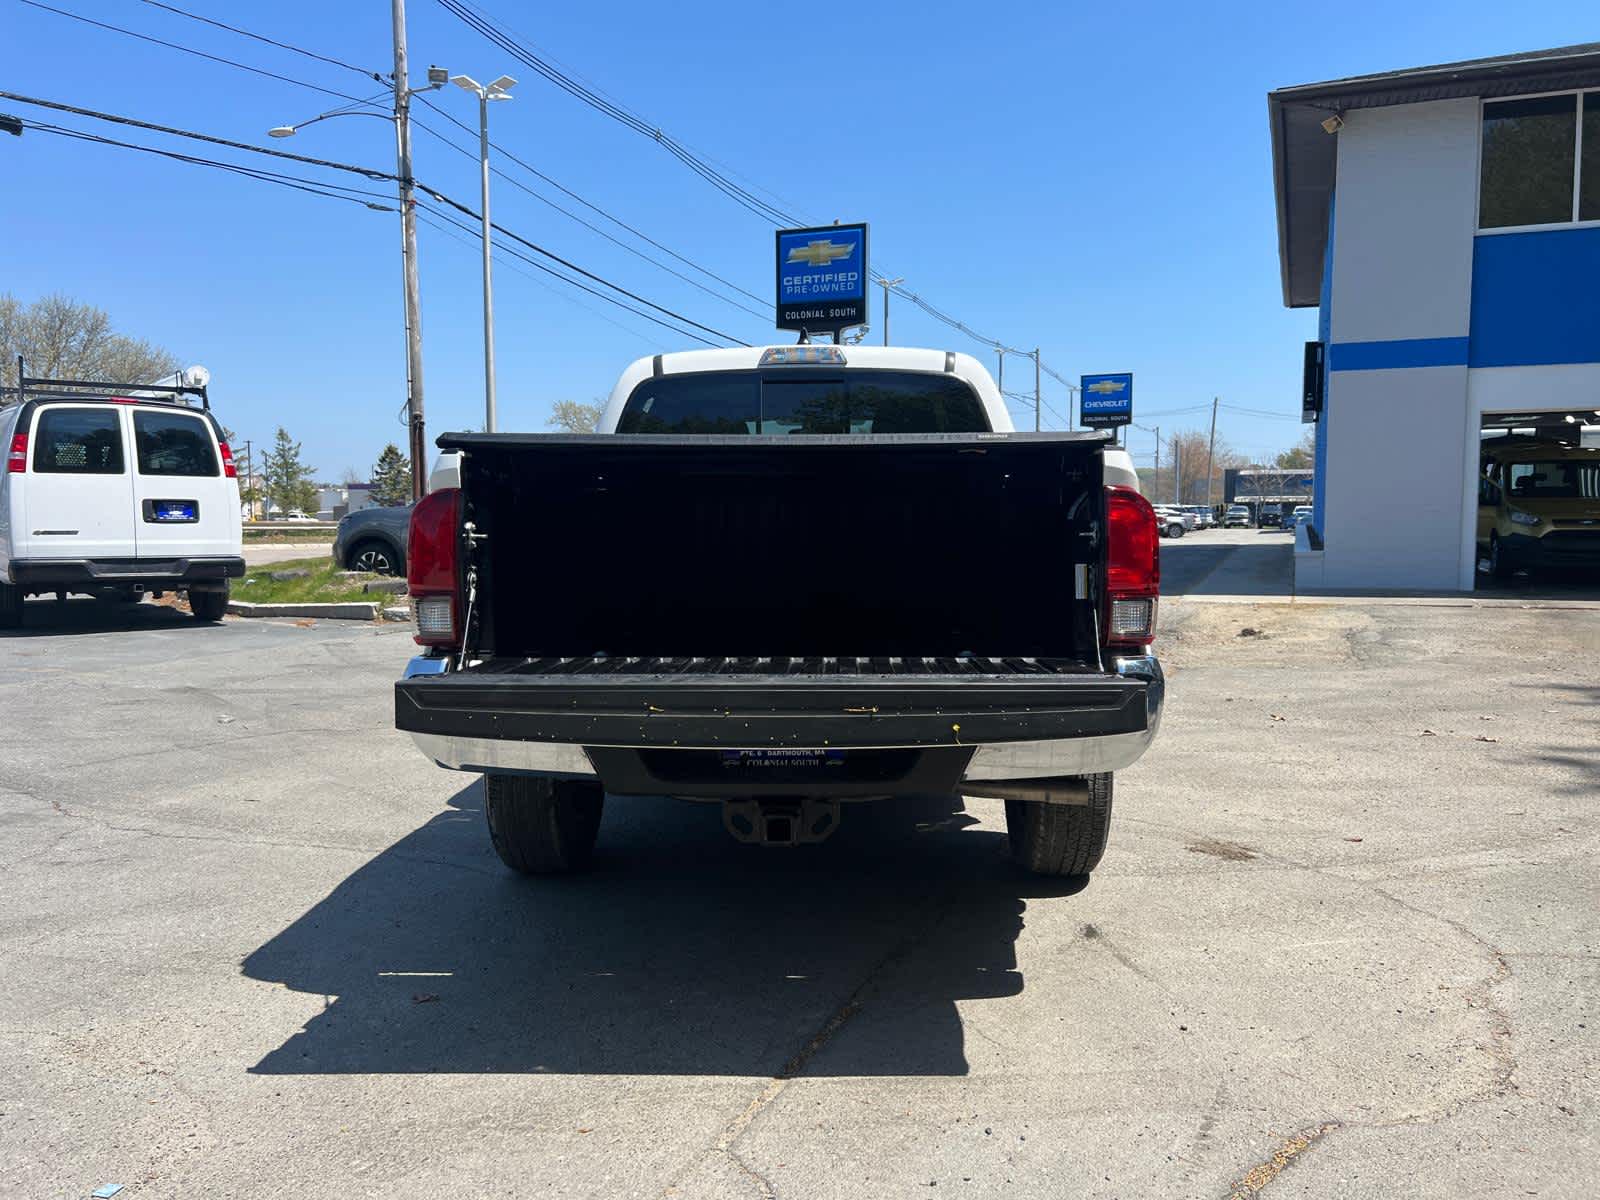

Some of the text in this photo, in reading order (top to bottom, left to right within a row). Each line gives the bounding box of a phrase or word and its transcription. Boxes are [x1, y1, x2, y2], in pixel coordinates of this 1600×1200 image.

[784, 272, 857, 285] CERTIFIED
[787, 282, 854, 294] PRE-OWNED
[786, 308, 856, 319] COLONIAL SOUTH
[1085, 400, 1128, 408] CHEVROLET
[746, 759, 819, 767] COLONIAL SOUTH
